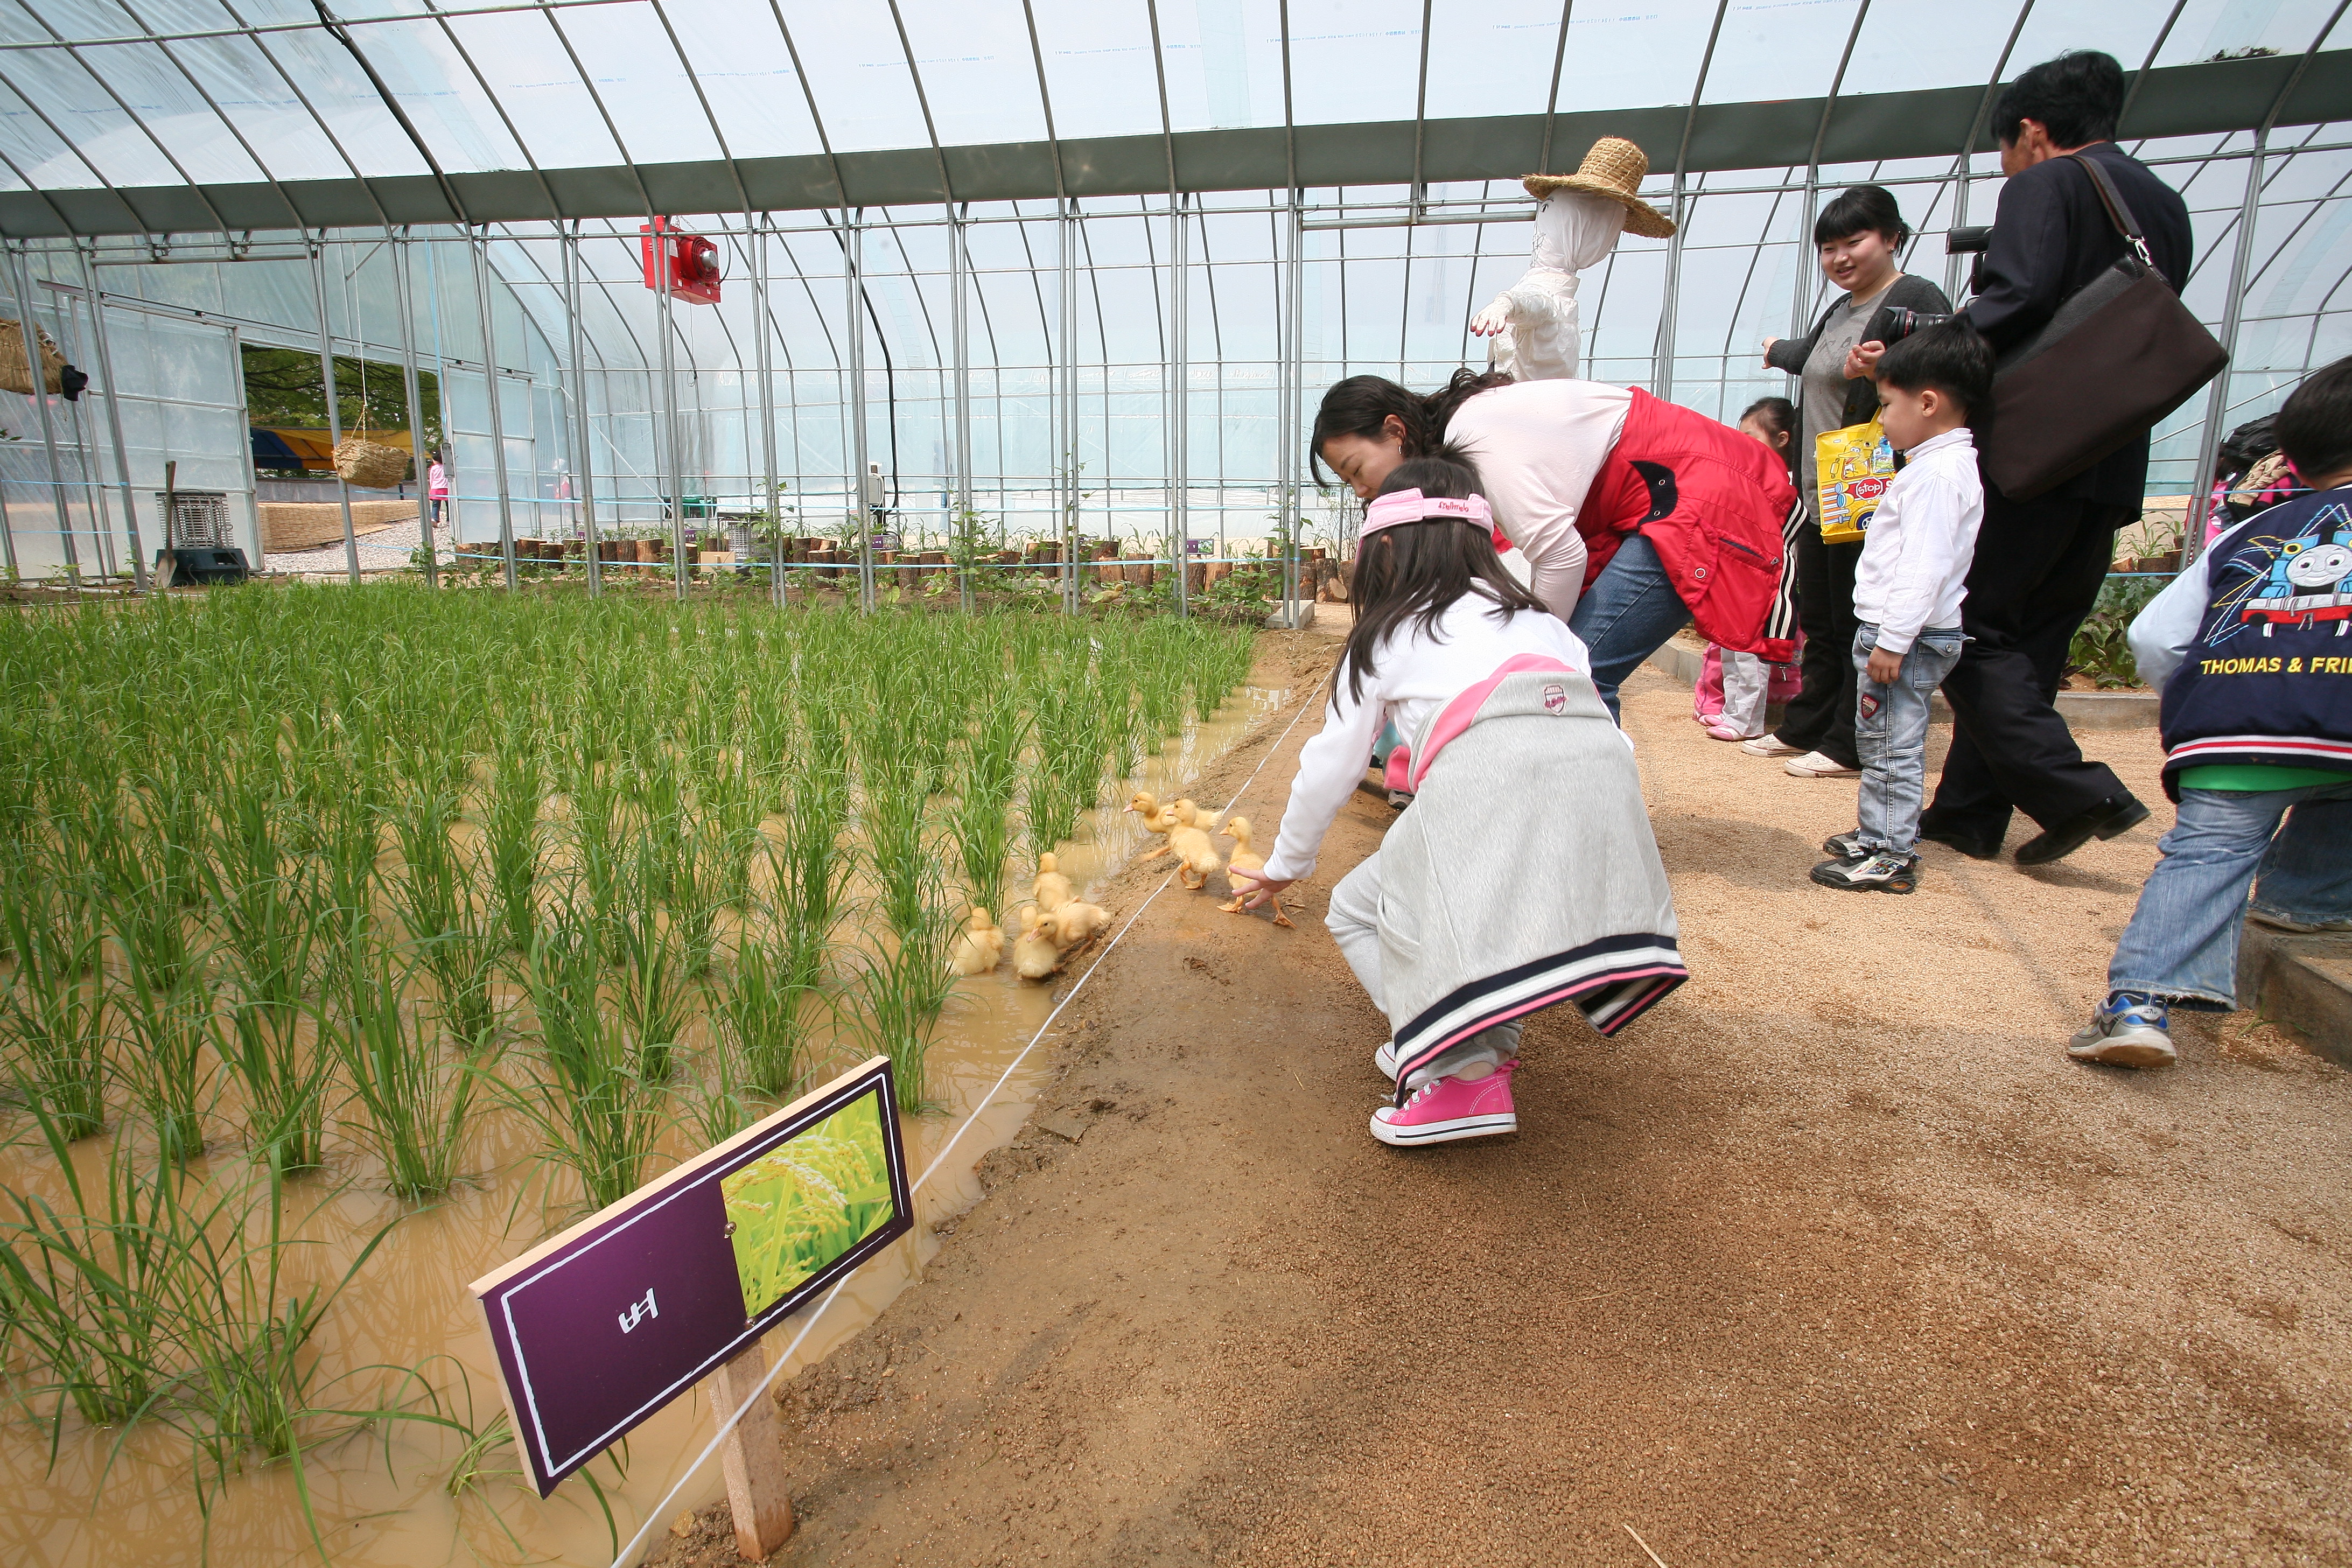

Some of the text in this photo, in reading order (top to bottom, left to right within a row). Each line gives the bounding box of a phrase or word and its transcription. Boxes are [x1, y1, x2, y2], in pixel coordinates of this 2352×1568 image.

[1858, 483, 1880, 495] stop
[2200, 657, 2281, 675] THOMAS
[2287, 657, 2303, 673] &
[618, 1287, 659, 1334] 벼
